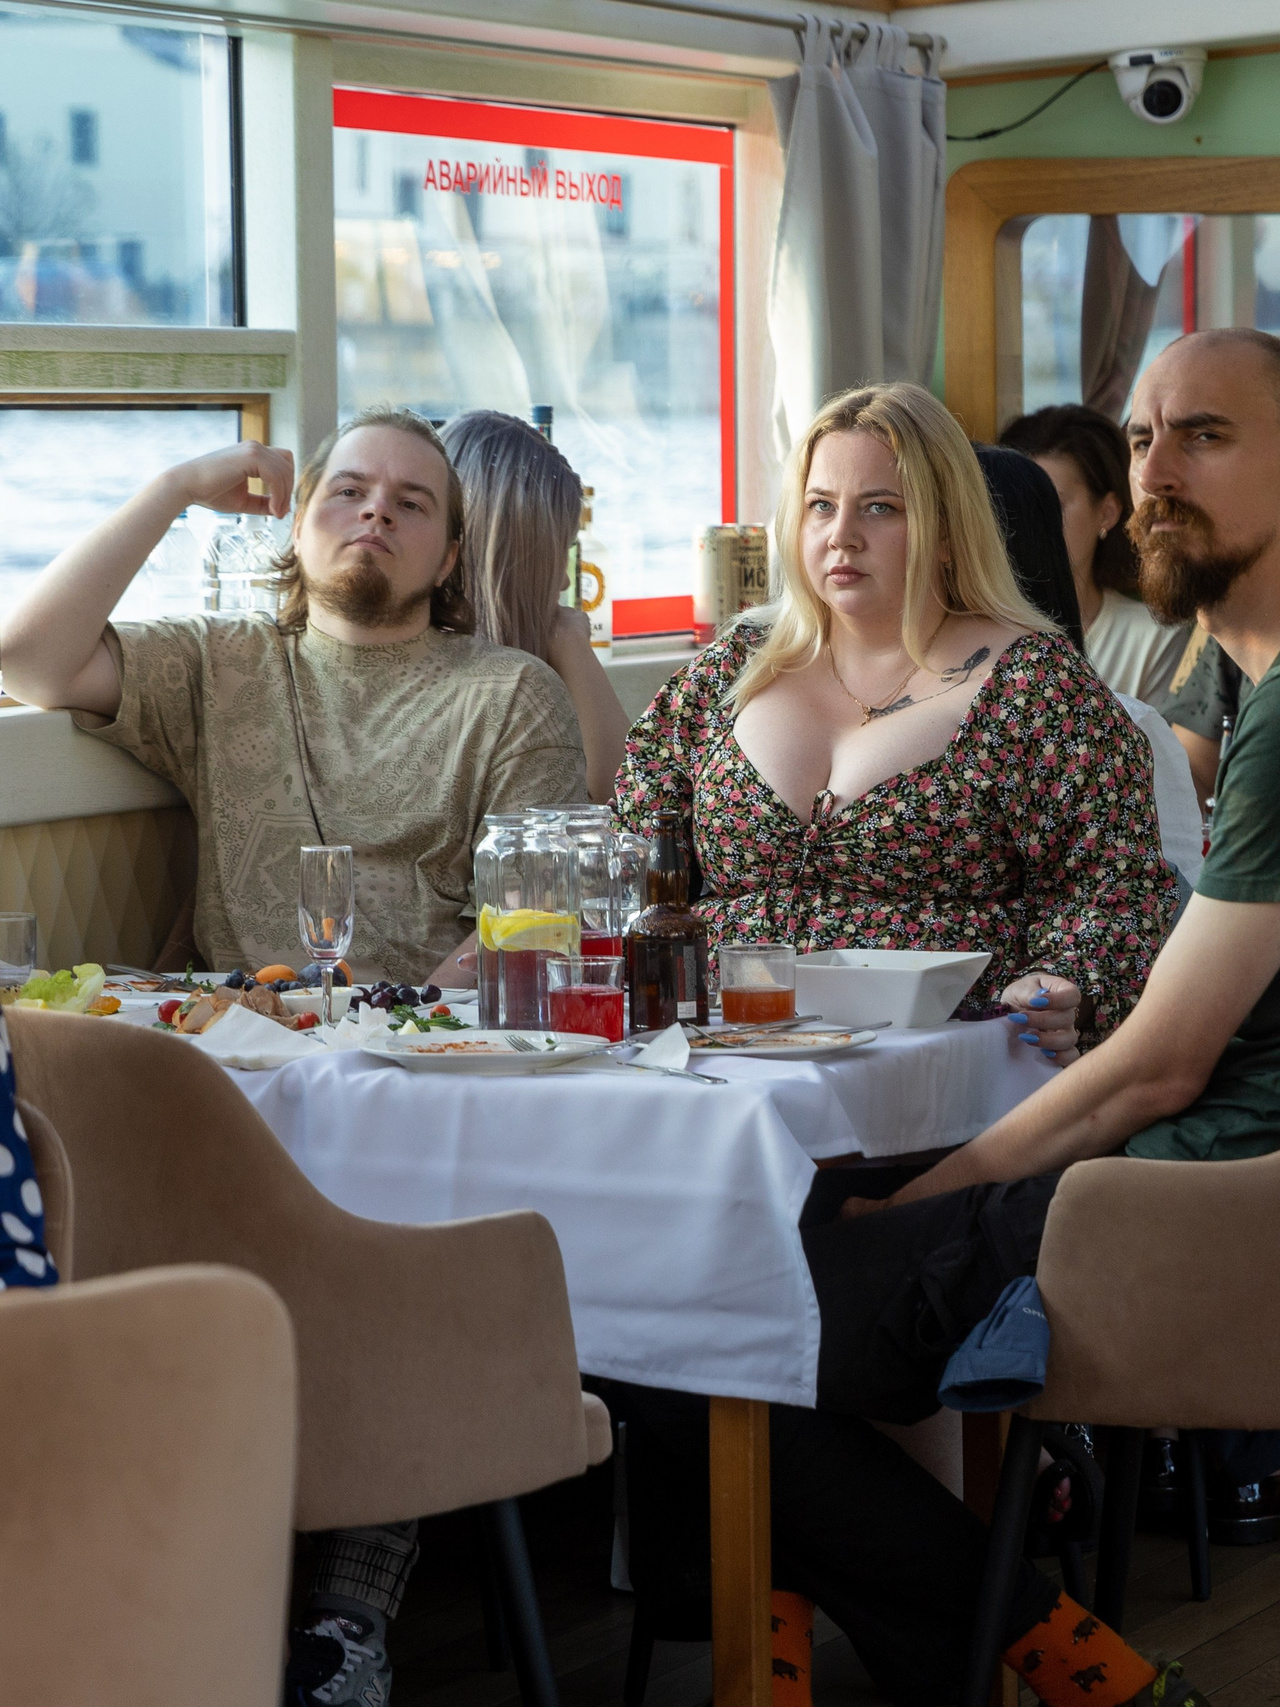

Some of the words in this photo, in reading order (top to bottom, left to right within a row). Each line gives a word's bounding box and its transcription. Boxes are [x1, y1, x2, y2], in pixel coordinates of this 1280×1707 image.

[423, 157, 549, 199] АВАРИЙНЫЙ
[555, 170, 623, 212] ВЫХОД
[739, 567, 766, 588] ИС
